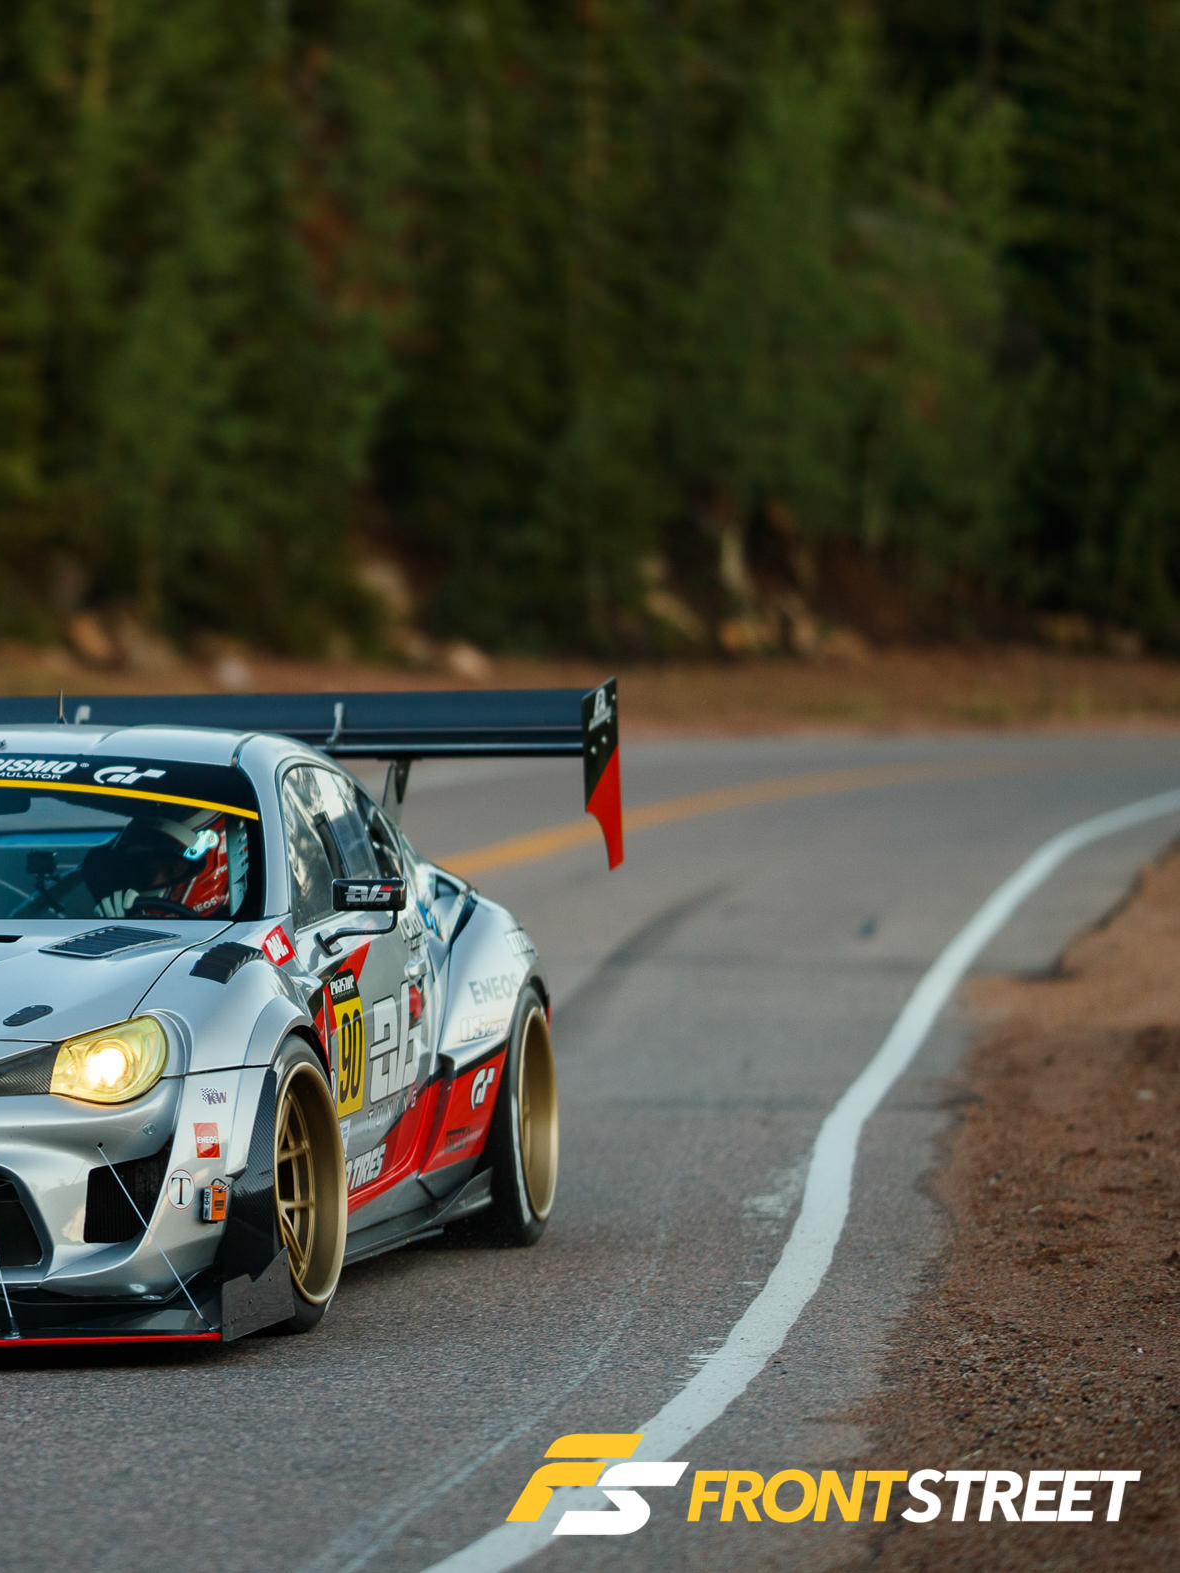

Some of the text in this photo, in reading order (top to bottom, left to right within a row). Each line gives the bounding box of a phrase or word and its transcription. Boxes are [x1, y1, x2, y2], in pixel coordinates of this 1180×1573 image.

[340, 1008, 363, 1104] 90
[368, 1088, 418, 1128] TUNING
[350, 1143, 387, 1191] TIRES
[170, 1176, 191, 1206] T
